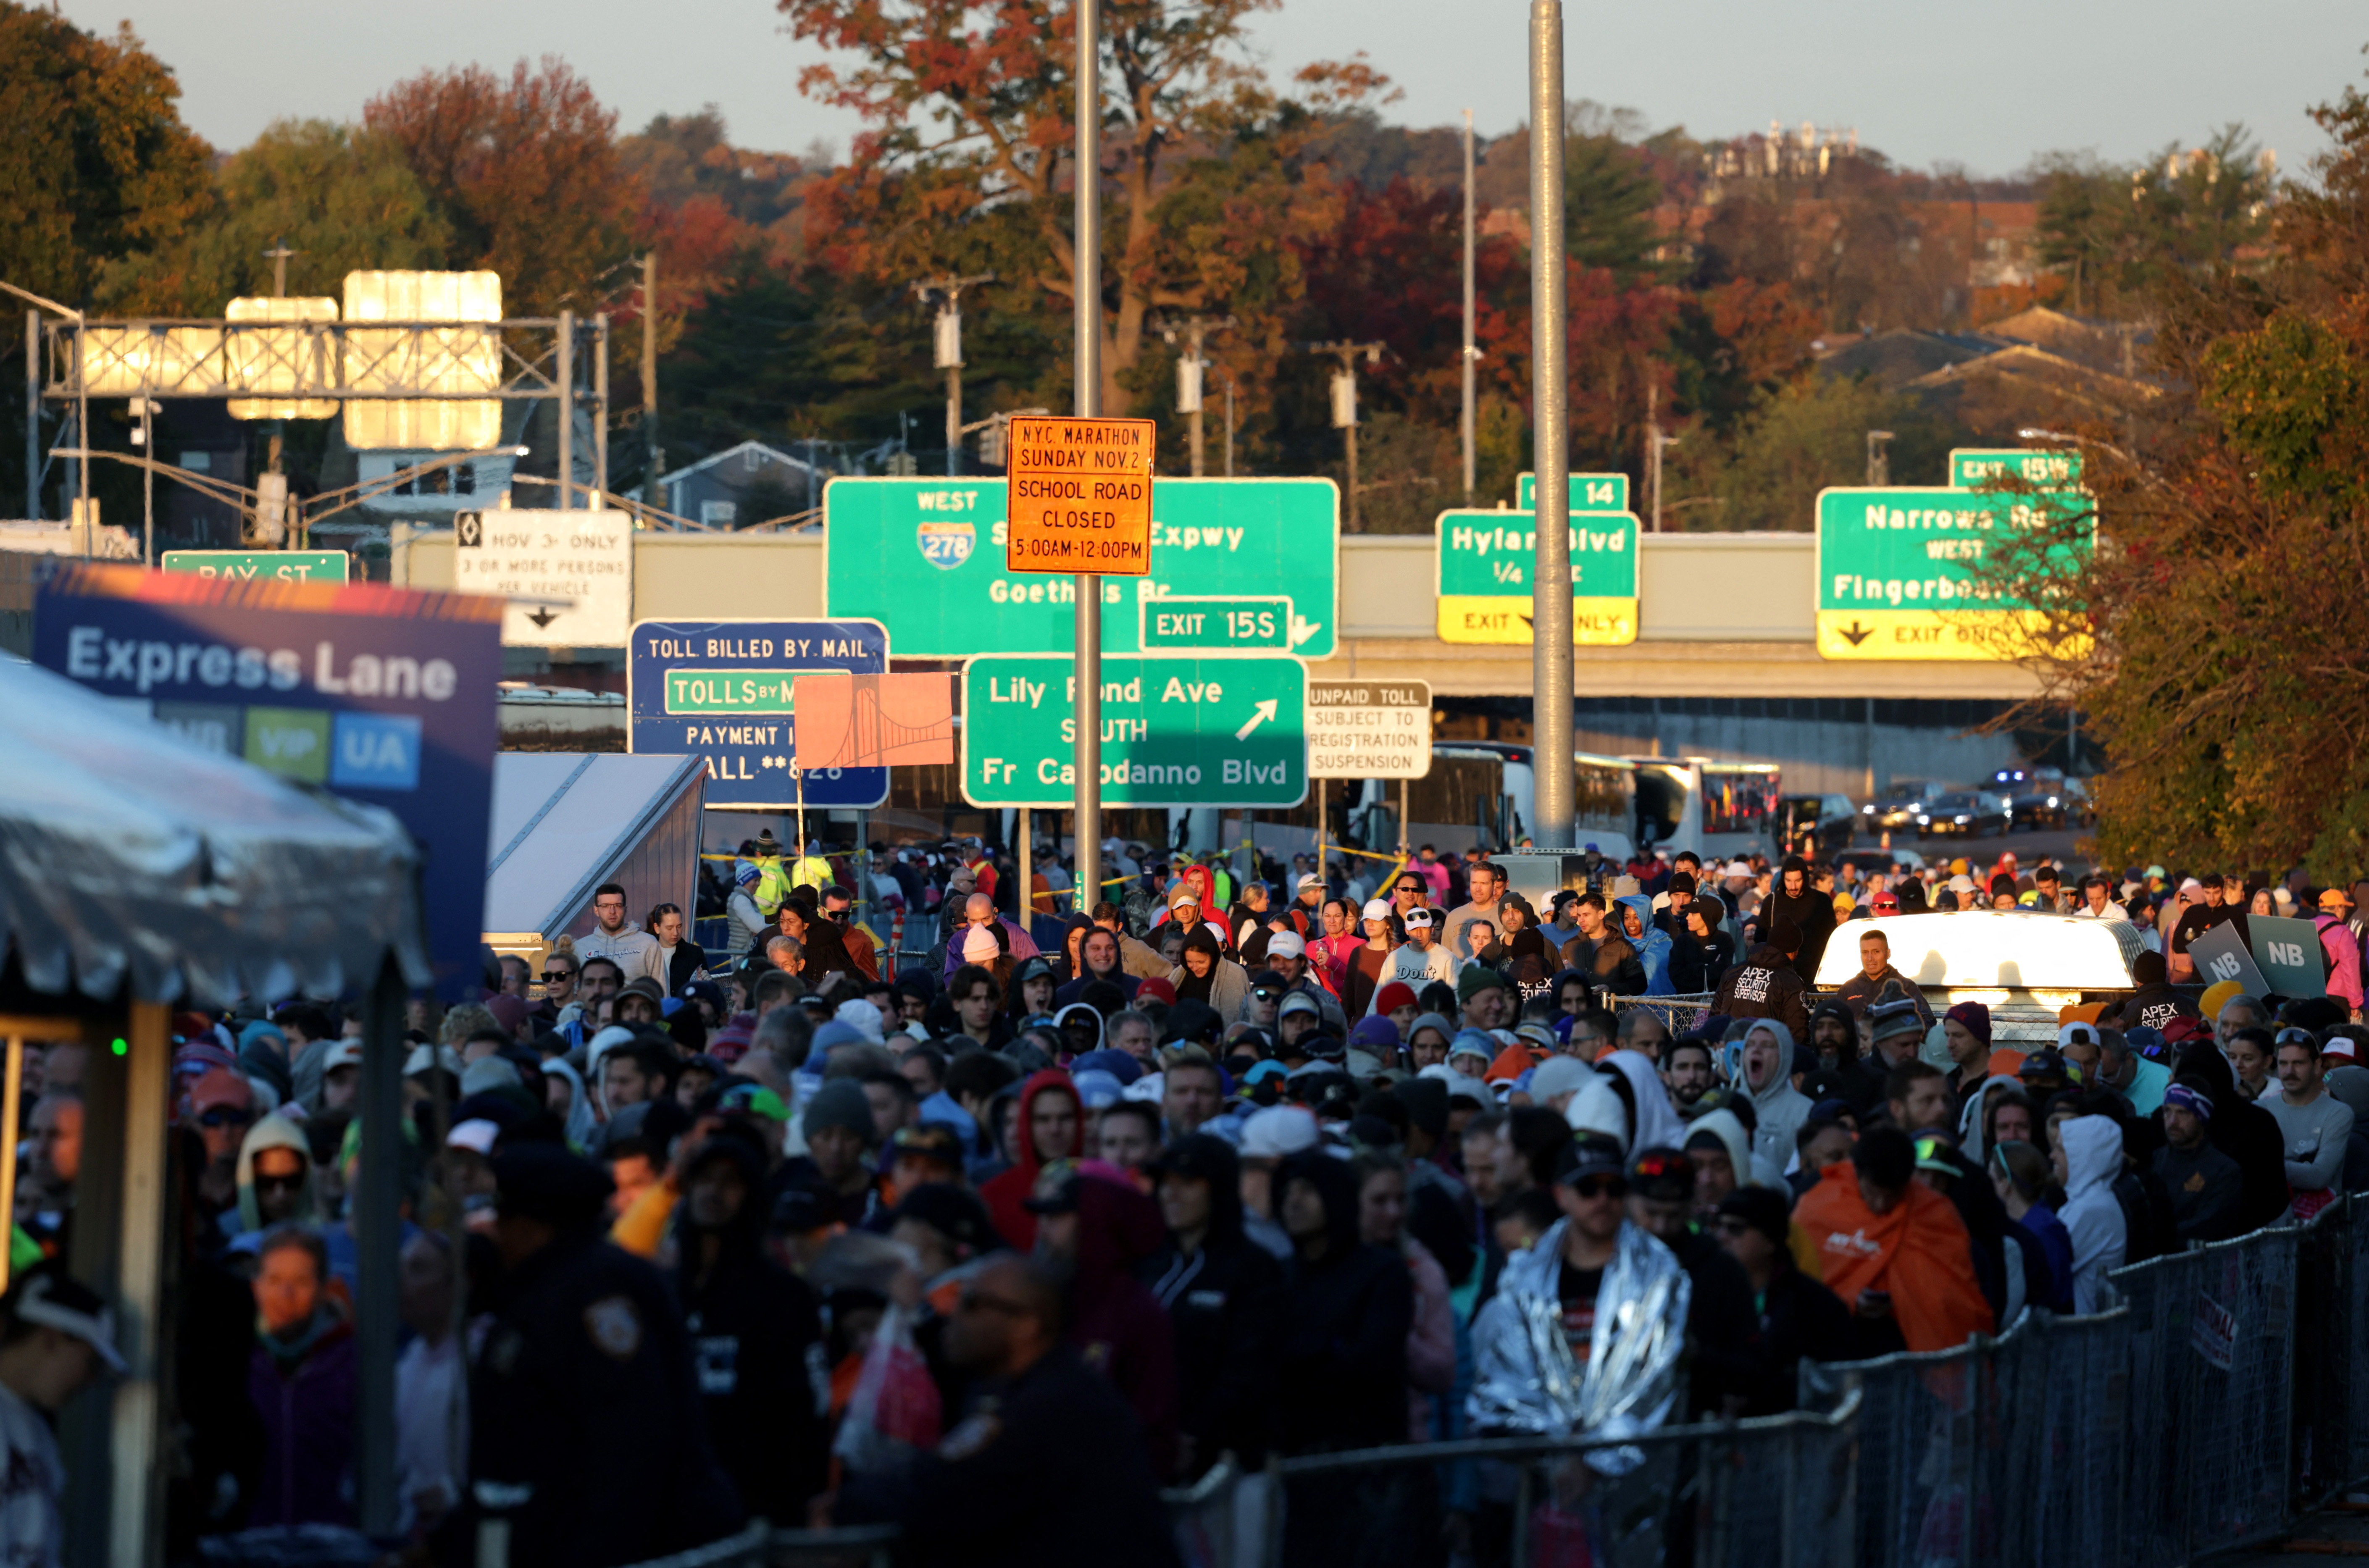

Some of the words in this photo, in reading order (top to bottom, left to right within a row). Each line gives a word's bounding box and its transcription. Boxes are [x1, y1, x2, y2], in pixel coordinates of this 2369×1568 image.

[1023, 426, 1055, 444] N.Y.C.
[1065, 427, 1139, 445] MARATHON
[1021, 449, 1086, 467] SUNDAY
[1018, 480, 1086, 499] SCHOOL
[1094, 483, 1142, 500] ROAD
[1585, 482, 1614, 504] 14
[917, 491, 978, 512] WEST
[1043, 510, 1115, 529] CLOSED
[492, 533, 531, 548] HOV
[570, 535, 618, 549] ONLY
[1151, 521, 1244, 552] Expwy
[925, 536, 970, 559] 278
[1926, 539, 1985, 559] WEST
[463, 559, 471, 573] 3
[479, 559, 499, 573] OR
[507, 559, 548, 574] MORE
[557, 560, 625, 575] PERSONS
[531, 581, 590, 595] VEHICLE
[1156, 613, 1206, 636] EXIT
[1227, 612, 1275, 638] 15S
[1465, 612, 1510, 629] EXIT
[1574, 614, 1622, 631] NLY
[1895, 626, 1943, 643] EXIT
[649, 639, 699, 658] TOLL
[707, 639, 774, 658] BILLED
[784, 639, 811, 658] BY
[822, 639, 868, 658] MAIL
[67, 624, 302, 695] Express
[314, 640, 458, 702] Lane
[990, 676, 1046, 709] Lily
[1160, 676, 1223, 703] Ave
[1309, 688, 1370, 705] UNPAID
[1379, 688, 1420, 705] TOLL
[1315, 711, 1383, 726] SUBJECT
[1395, 711, 1414, 726] TO
[686, 726, 778, 746] PAYMENT
[1061, 718, 1147, 743] SUTH
[1309, 733, 1419, 747] REGISTRATION
[258, 725, 318, 759] VIP
[343, 729, 407, 772] UA
[709, 756, 755, 780] ALL
[983, 758, 1017, 785] Fr
[1037, 757, 1202, 785] Caodanno
[1222, 758, 1286, 785] Blvd
[1315, 755, 1412, 769] SUSPENSION
[585, 948, 641, 959] Champion
[2267, 941, 2305, 967] NB
[1396, 964, 1436, 980] Don't
[1741, 966, 1774, 982] APEX
[2209, 952, 2241, 982] NB
[1736, 977, 1770, 992] SECURITY
[1734, 988, 1767, 1003] SUPERVISOR
[2141, 1002, 2178, 1020] APEX
